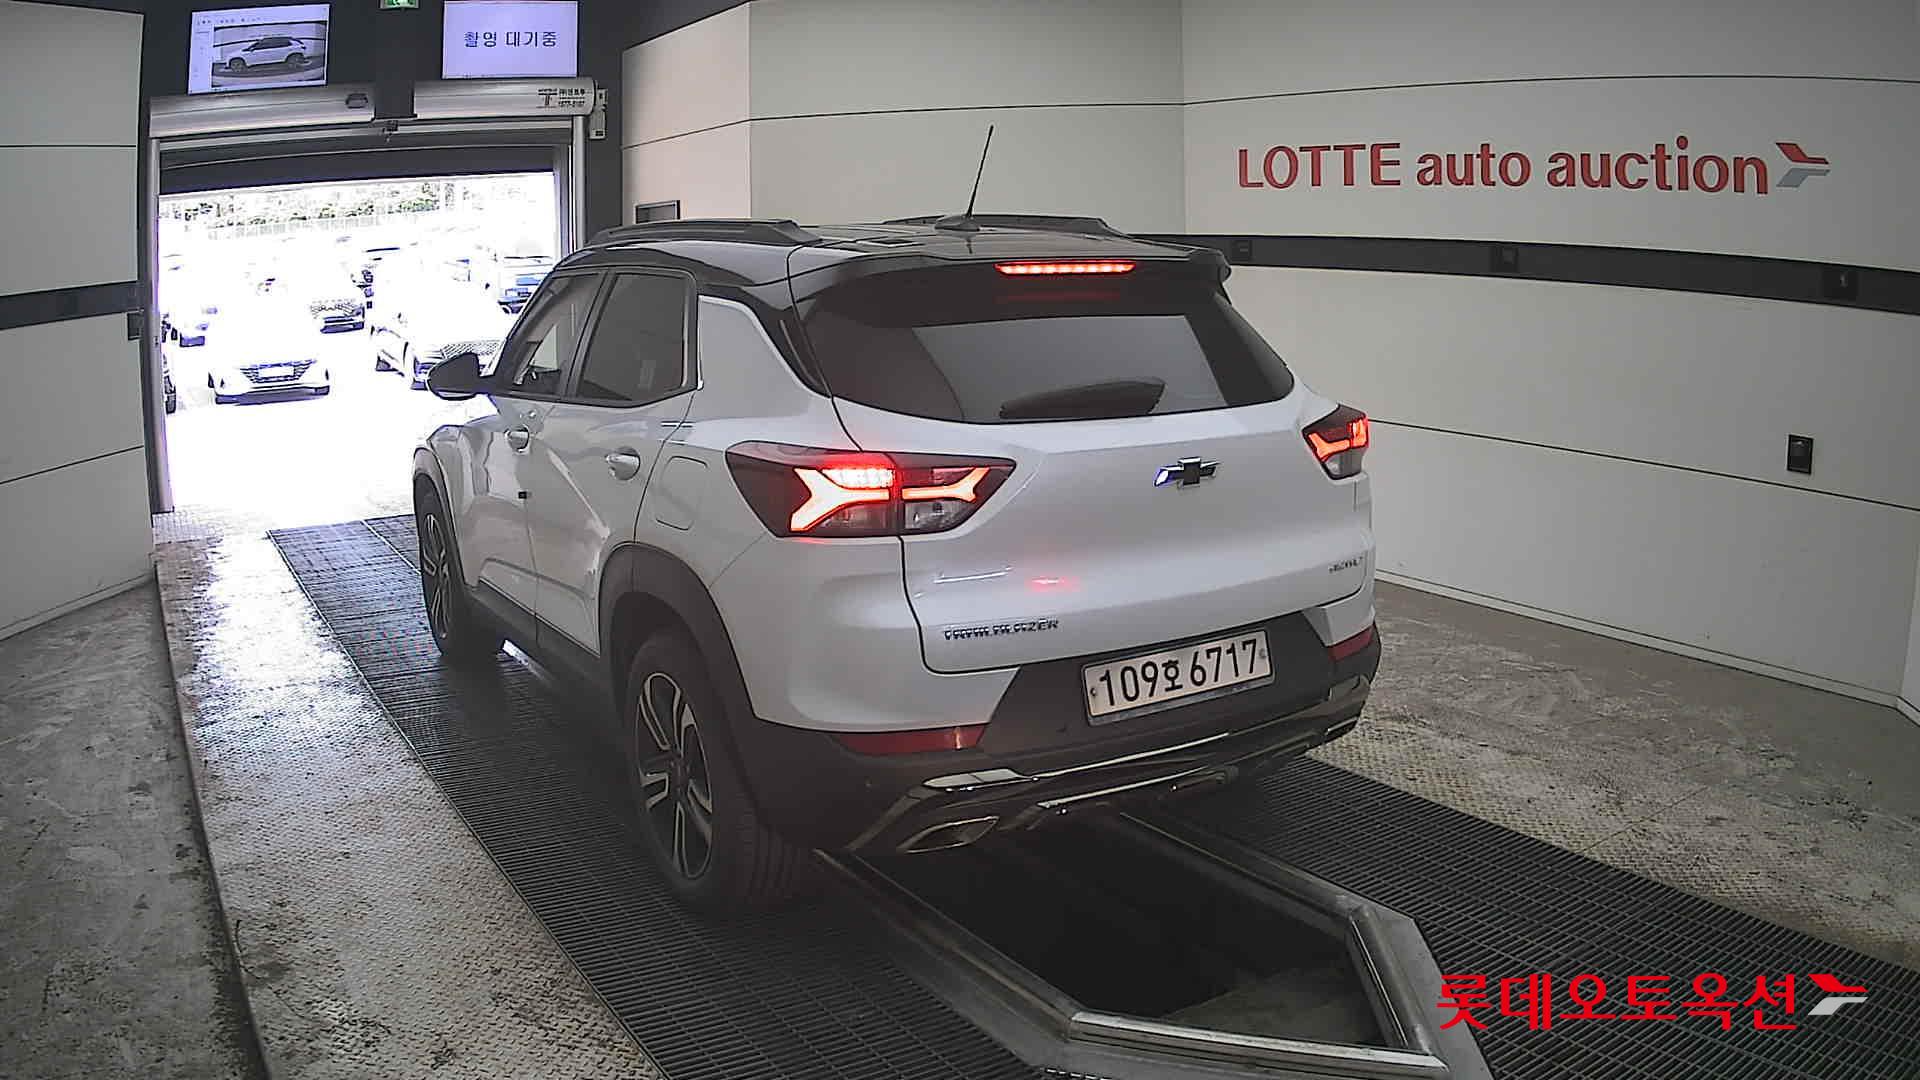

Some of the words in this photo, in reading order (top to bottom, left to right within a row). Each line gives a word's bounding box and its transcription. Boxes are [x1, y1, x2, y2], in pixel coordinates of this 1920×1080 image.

[505, 31, 557, 49] 대기중
[1238, 142, 1401, 190] LOTTE
[1415, 143, 1532, 188] auto
[1546, 135, 1769, 195] auction
[1098, 659, 1184, 707] 109호
[1189, 638, 1257, 687] 6717
